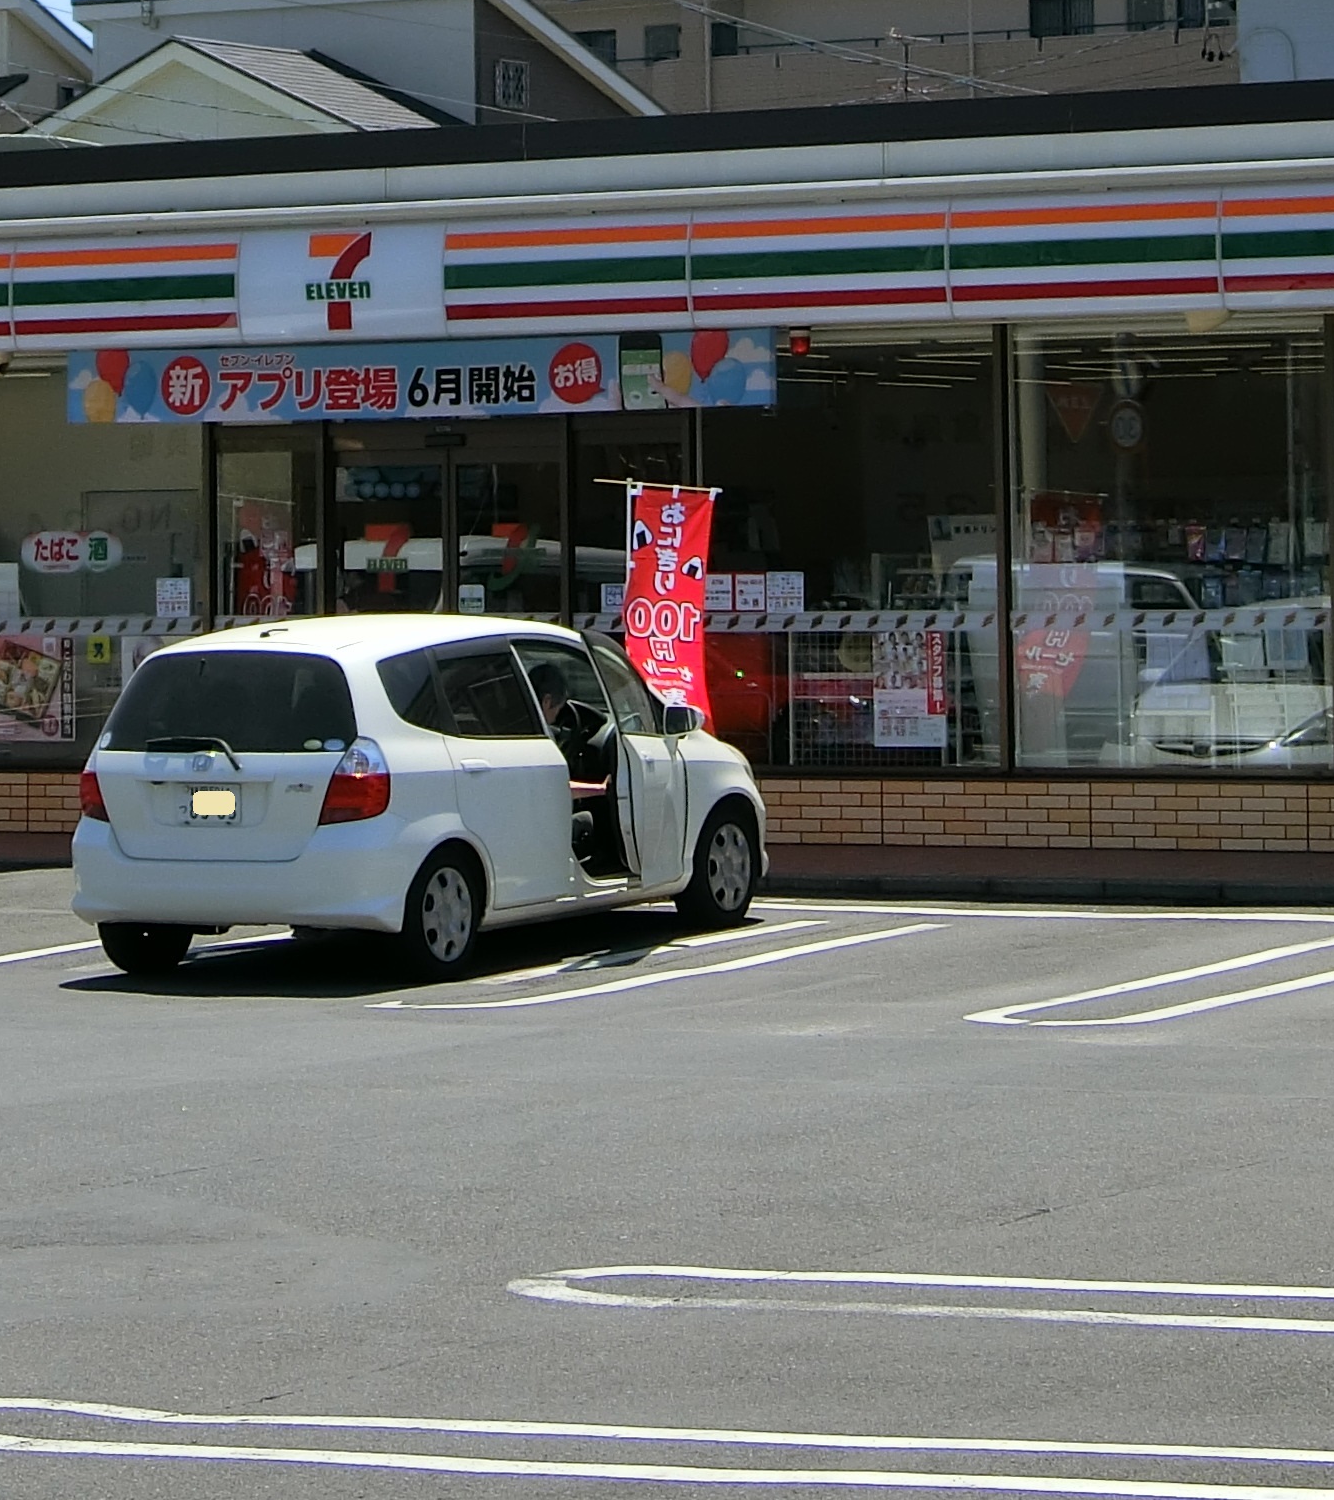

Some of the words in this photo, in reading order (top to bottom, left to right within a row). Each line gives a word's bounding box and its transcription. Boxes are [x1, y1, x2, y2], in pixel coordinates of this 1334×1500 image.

[553, 357, 598, 388] お得
[168, 365, 204, 407] 新
[218, 367, 398, 411] アプリ登場
[408, 366, 536, 407] 6月開始
[34, 537, 79, 562] たばこ
[88, 537, 108, 562] 酒
